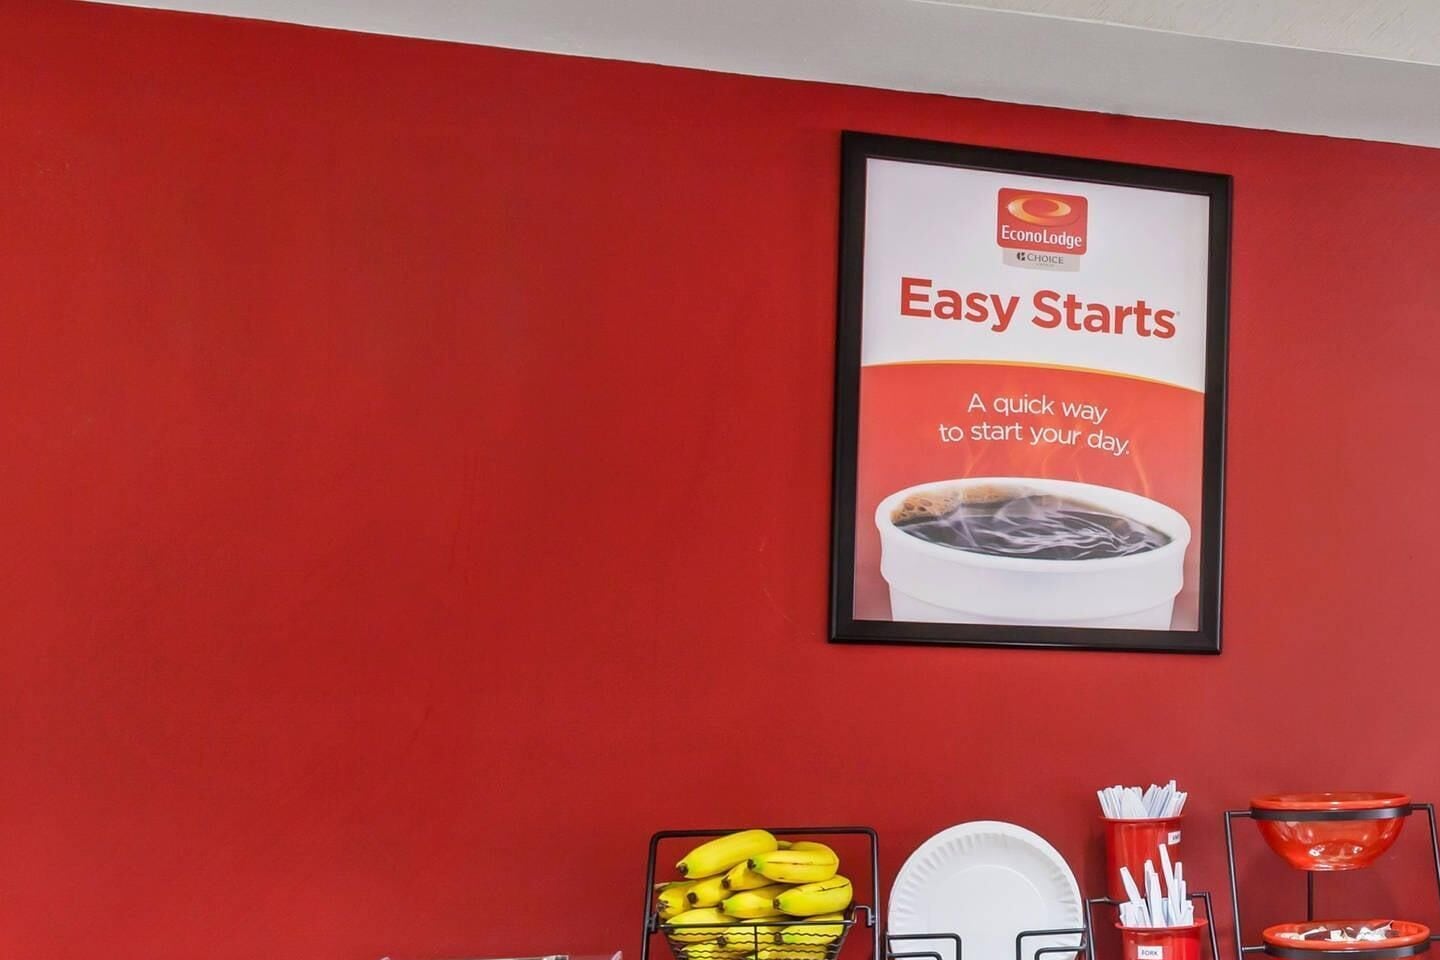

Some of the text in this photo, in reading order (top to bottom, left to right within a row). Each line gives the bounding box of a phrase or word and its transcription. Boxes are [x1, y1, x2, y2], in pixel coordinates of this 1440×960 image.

[1001, 224, 1083, 250] EconoLodge
[1026, 253, 1065, 265] CHOICE
[901, 276, 1177, 339] Easy Starts
[967, 393, 1108, 425] A quick way
[938, 422, 1130, 457] to start your day.
